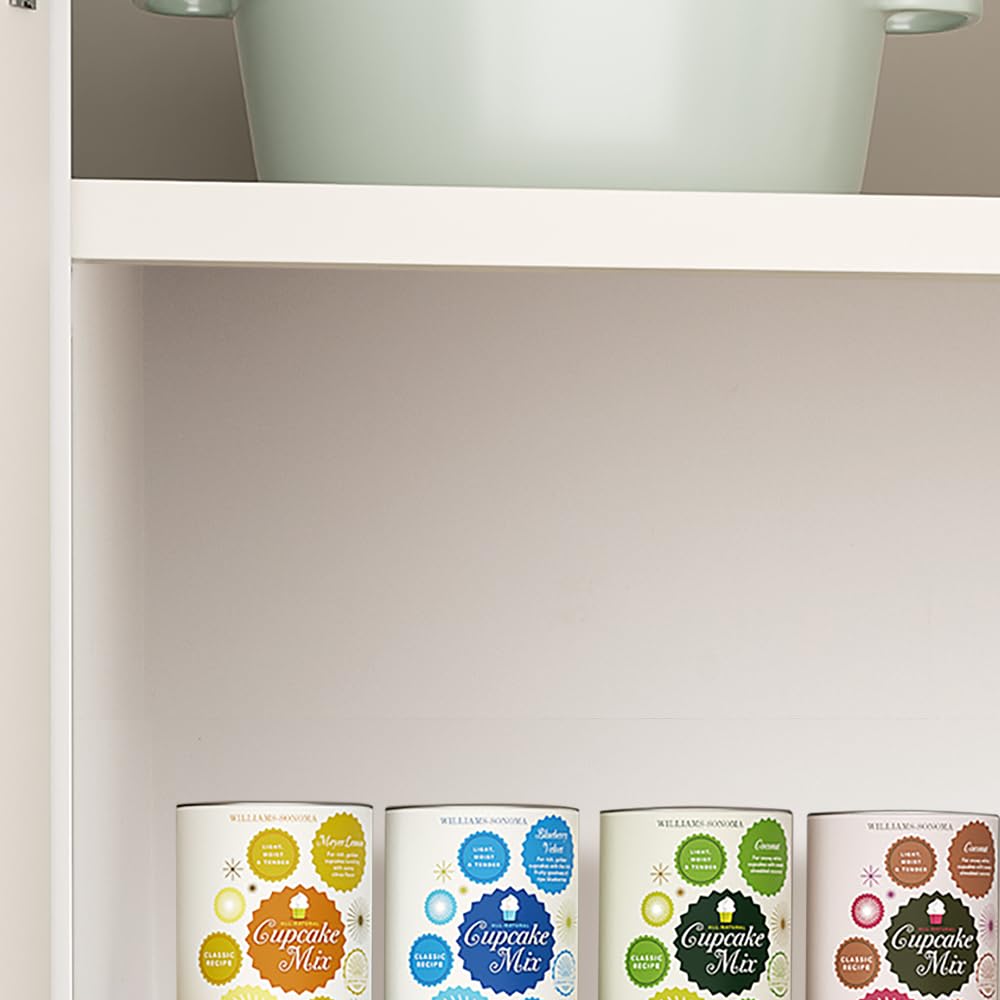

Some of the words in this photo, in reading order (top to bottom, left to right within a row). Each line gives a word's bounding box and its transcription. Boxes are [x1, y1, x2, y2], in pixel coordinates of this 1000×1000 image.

[253, 918, 341, 950] Cupcake
[464, 920, 550, 952] Cupcake
[681, 922, 765, 954] Cupcake
[891, 923, 974, 955] Cupcake
[203, 951, 236, 960] CLASSIC
[205, 960, 233, 968] RECIPE
[278, 945, 334, 973] Mix
[414, 953, 446, 961] CLASSIC
[416, 961, 444, 969] RECIPE
[489, 946, 543, 974] Mix
[633, 962, 661, 970] RECIPE
[706, 948, 758, 976] Mix
[840, 956, 873, 964] CLASSIC
[915, 950, 967, 977] Mix
